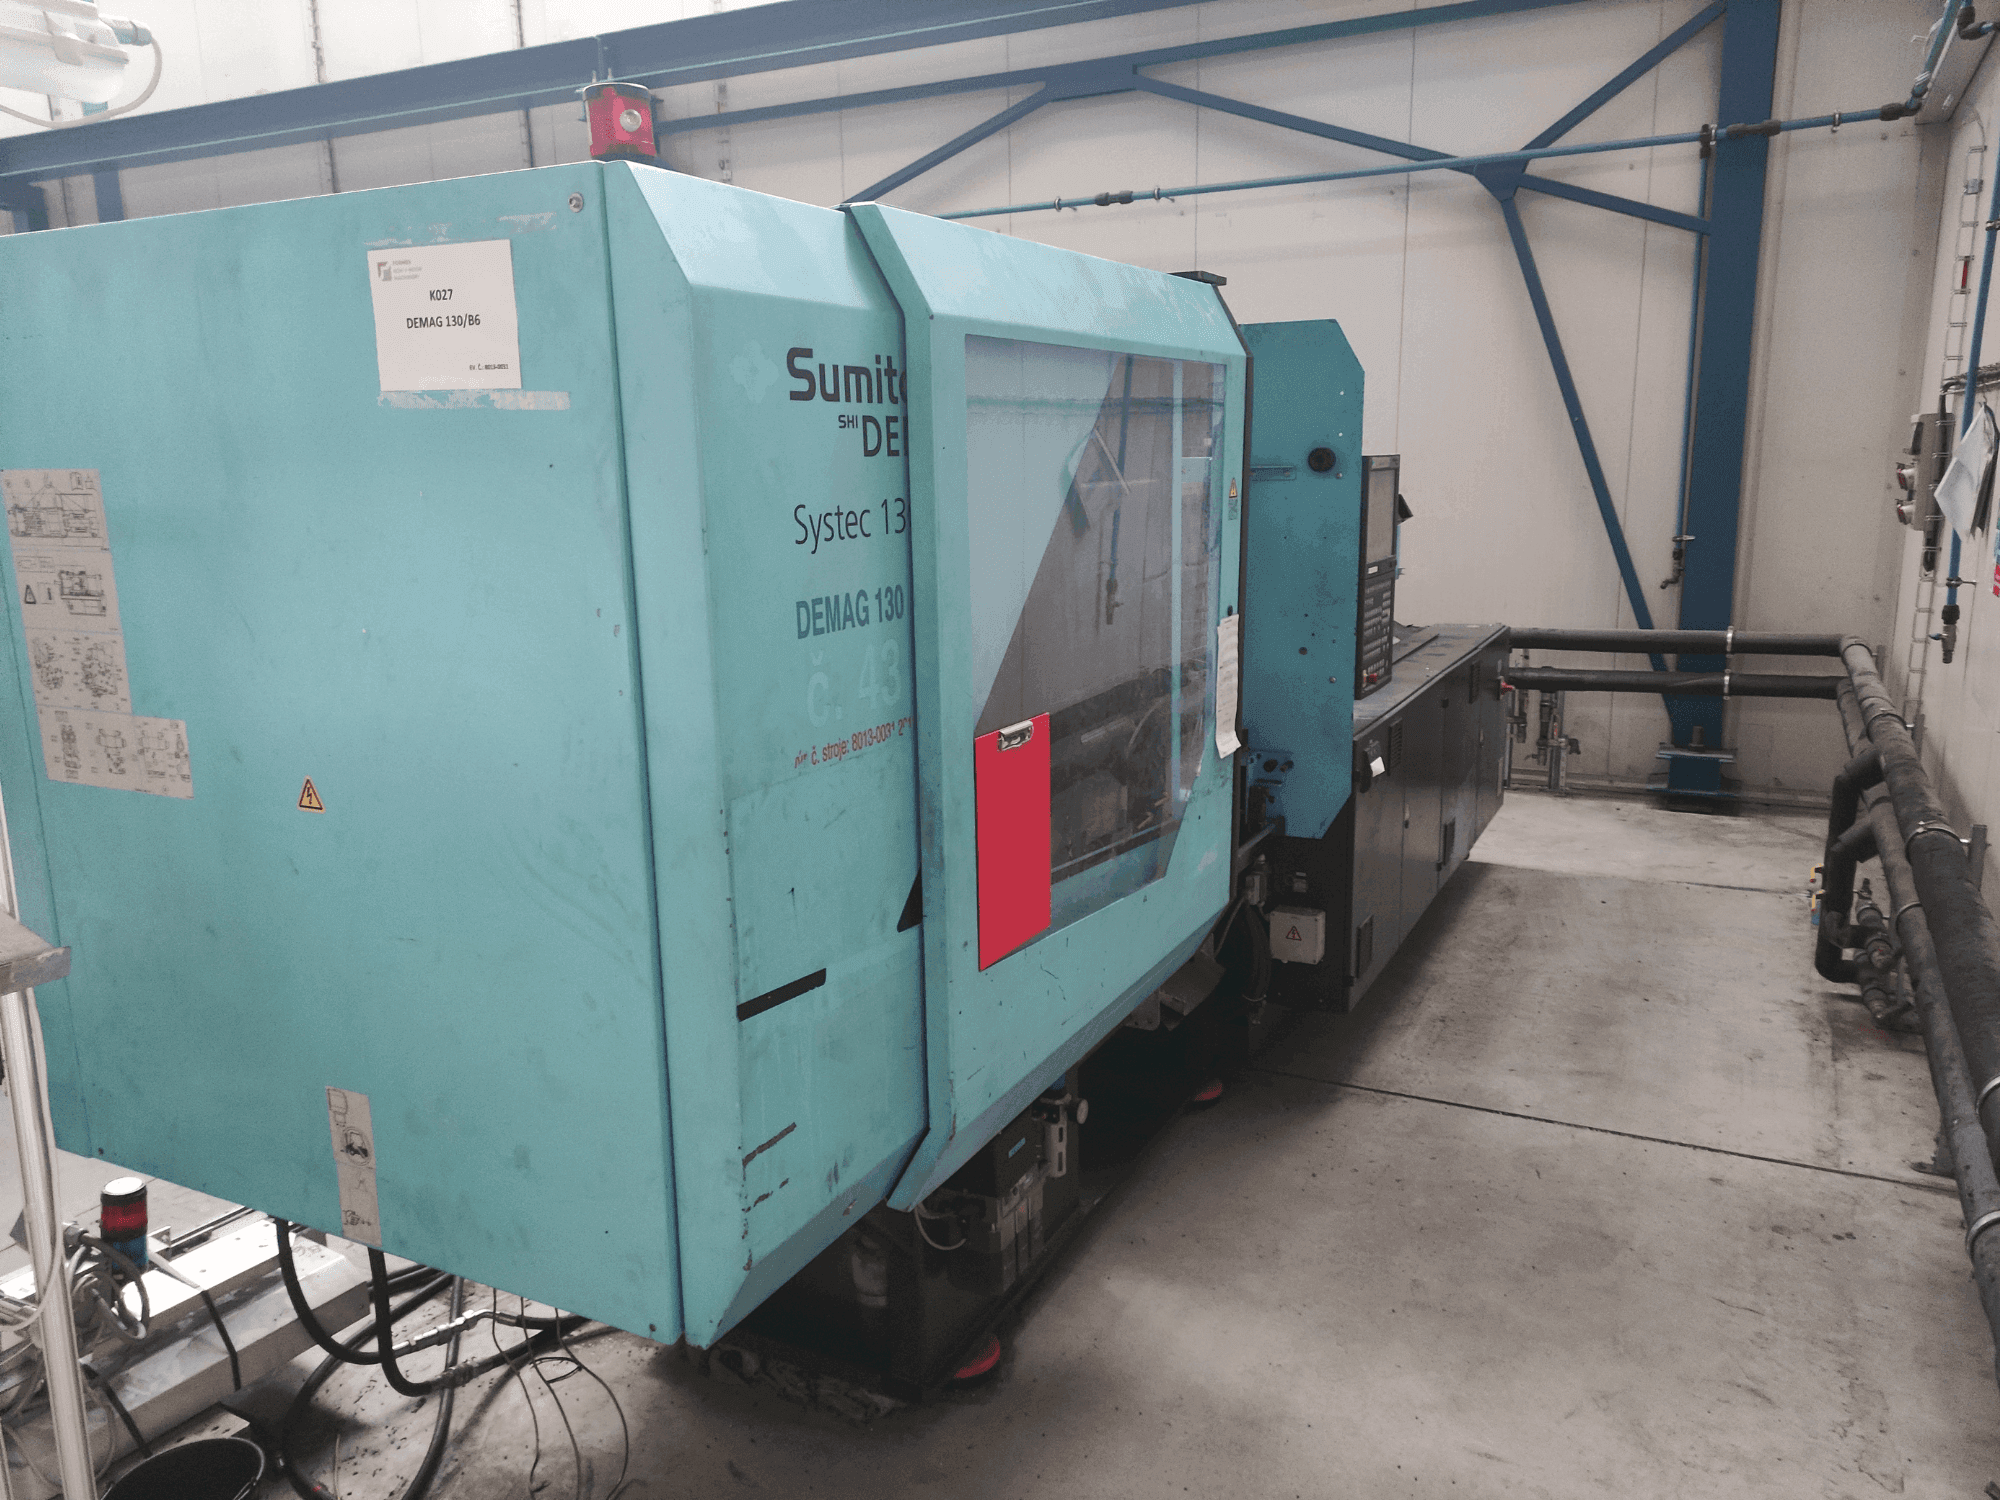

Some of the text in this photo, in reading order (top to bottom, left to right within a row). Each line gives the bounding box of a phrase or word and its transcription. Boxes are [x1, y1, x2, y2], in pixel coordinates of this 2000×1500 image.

[429, 288, 453, 301] K027
[406, 313, 481, 329] DEMAG 130/B6
[838, 414, 859, 429] SHI
[794, 503, 872, 555] Systec
[795, 584, 905, 640] DEMAG 130
[821, 737, 849, 762] stroje:
